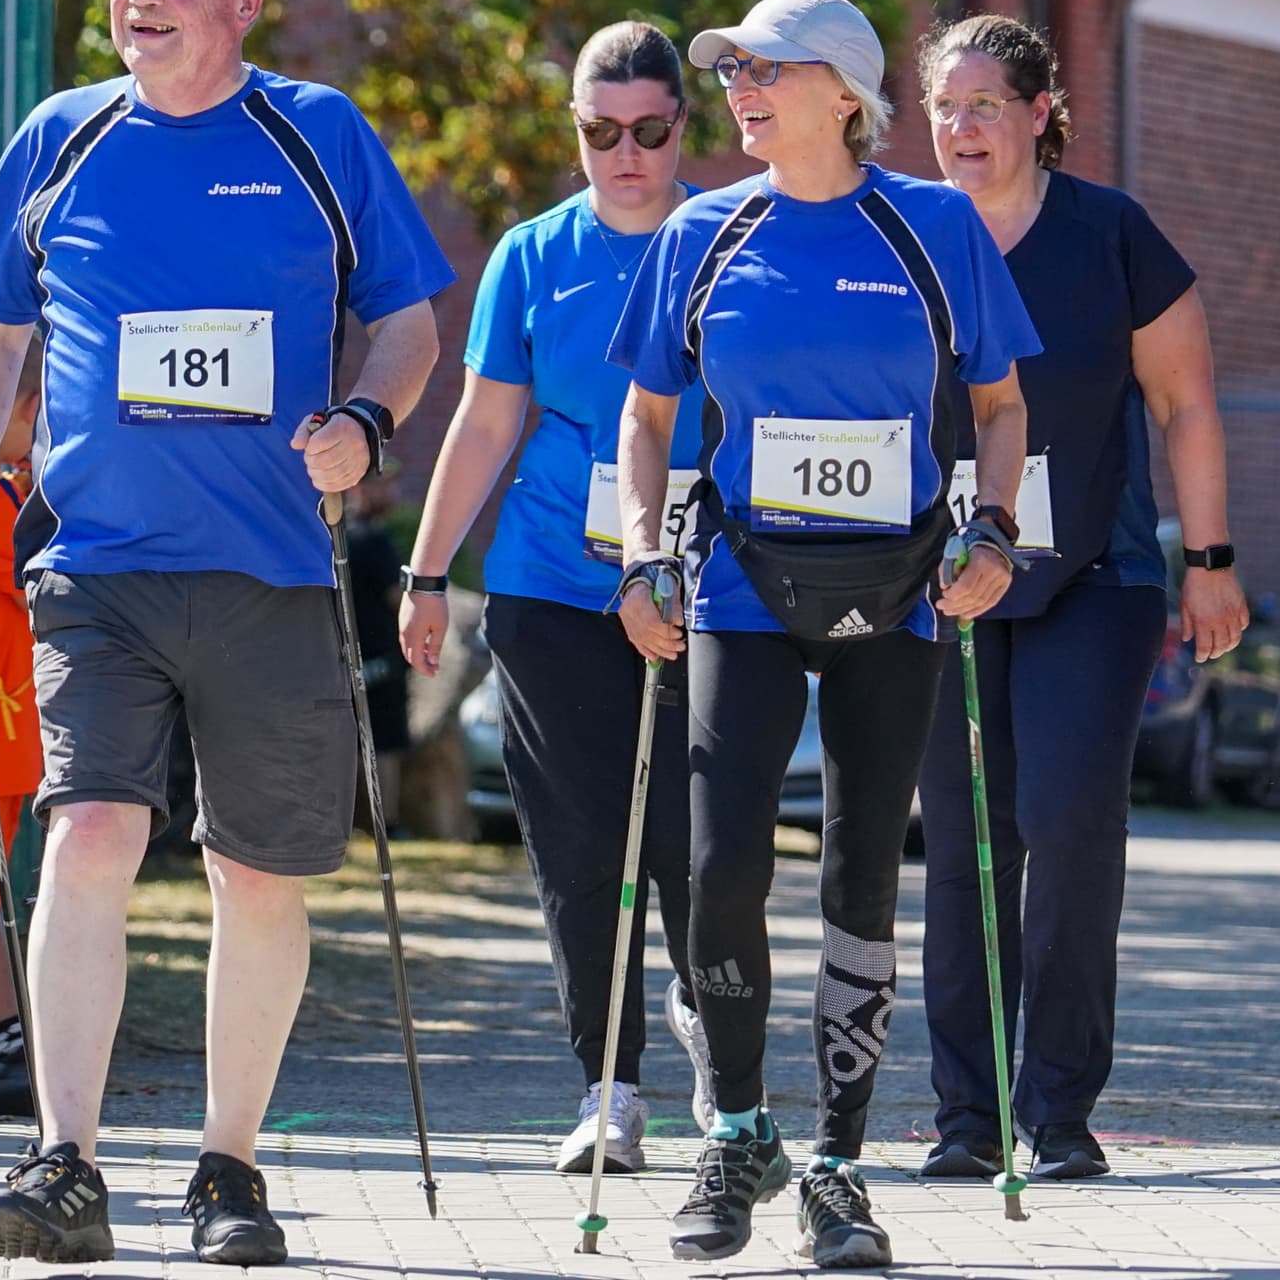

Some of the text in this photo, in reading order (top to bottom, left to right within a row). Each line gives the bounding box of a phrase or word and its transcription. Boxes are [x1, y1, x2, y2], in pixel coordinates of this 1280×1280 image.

[207, 182, 282, 195] Joachim
[835, 278, 908, 296] Susanne
[128, 322, 243, 335] Stellichter Straßenlauf
[159, 347, 229, 388] 181
[761, 430, 880, 445] Stellichter Straßenlauf
[793, 457, 872, 497] 180
[828, 624, 873, 638] adidas
